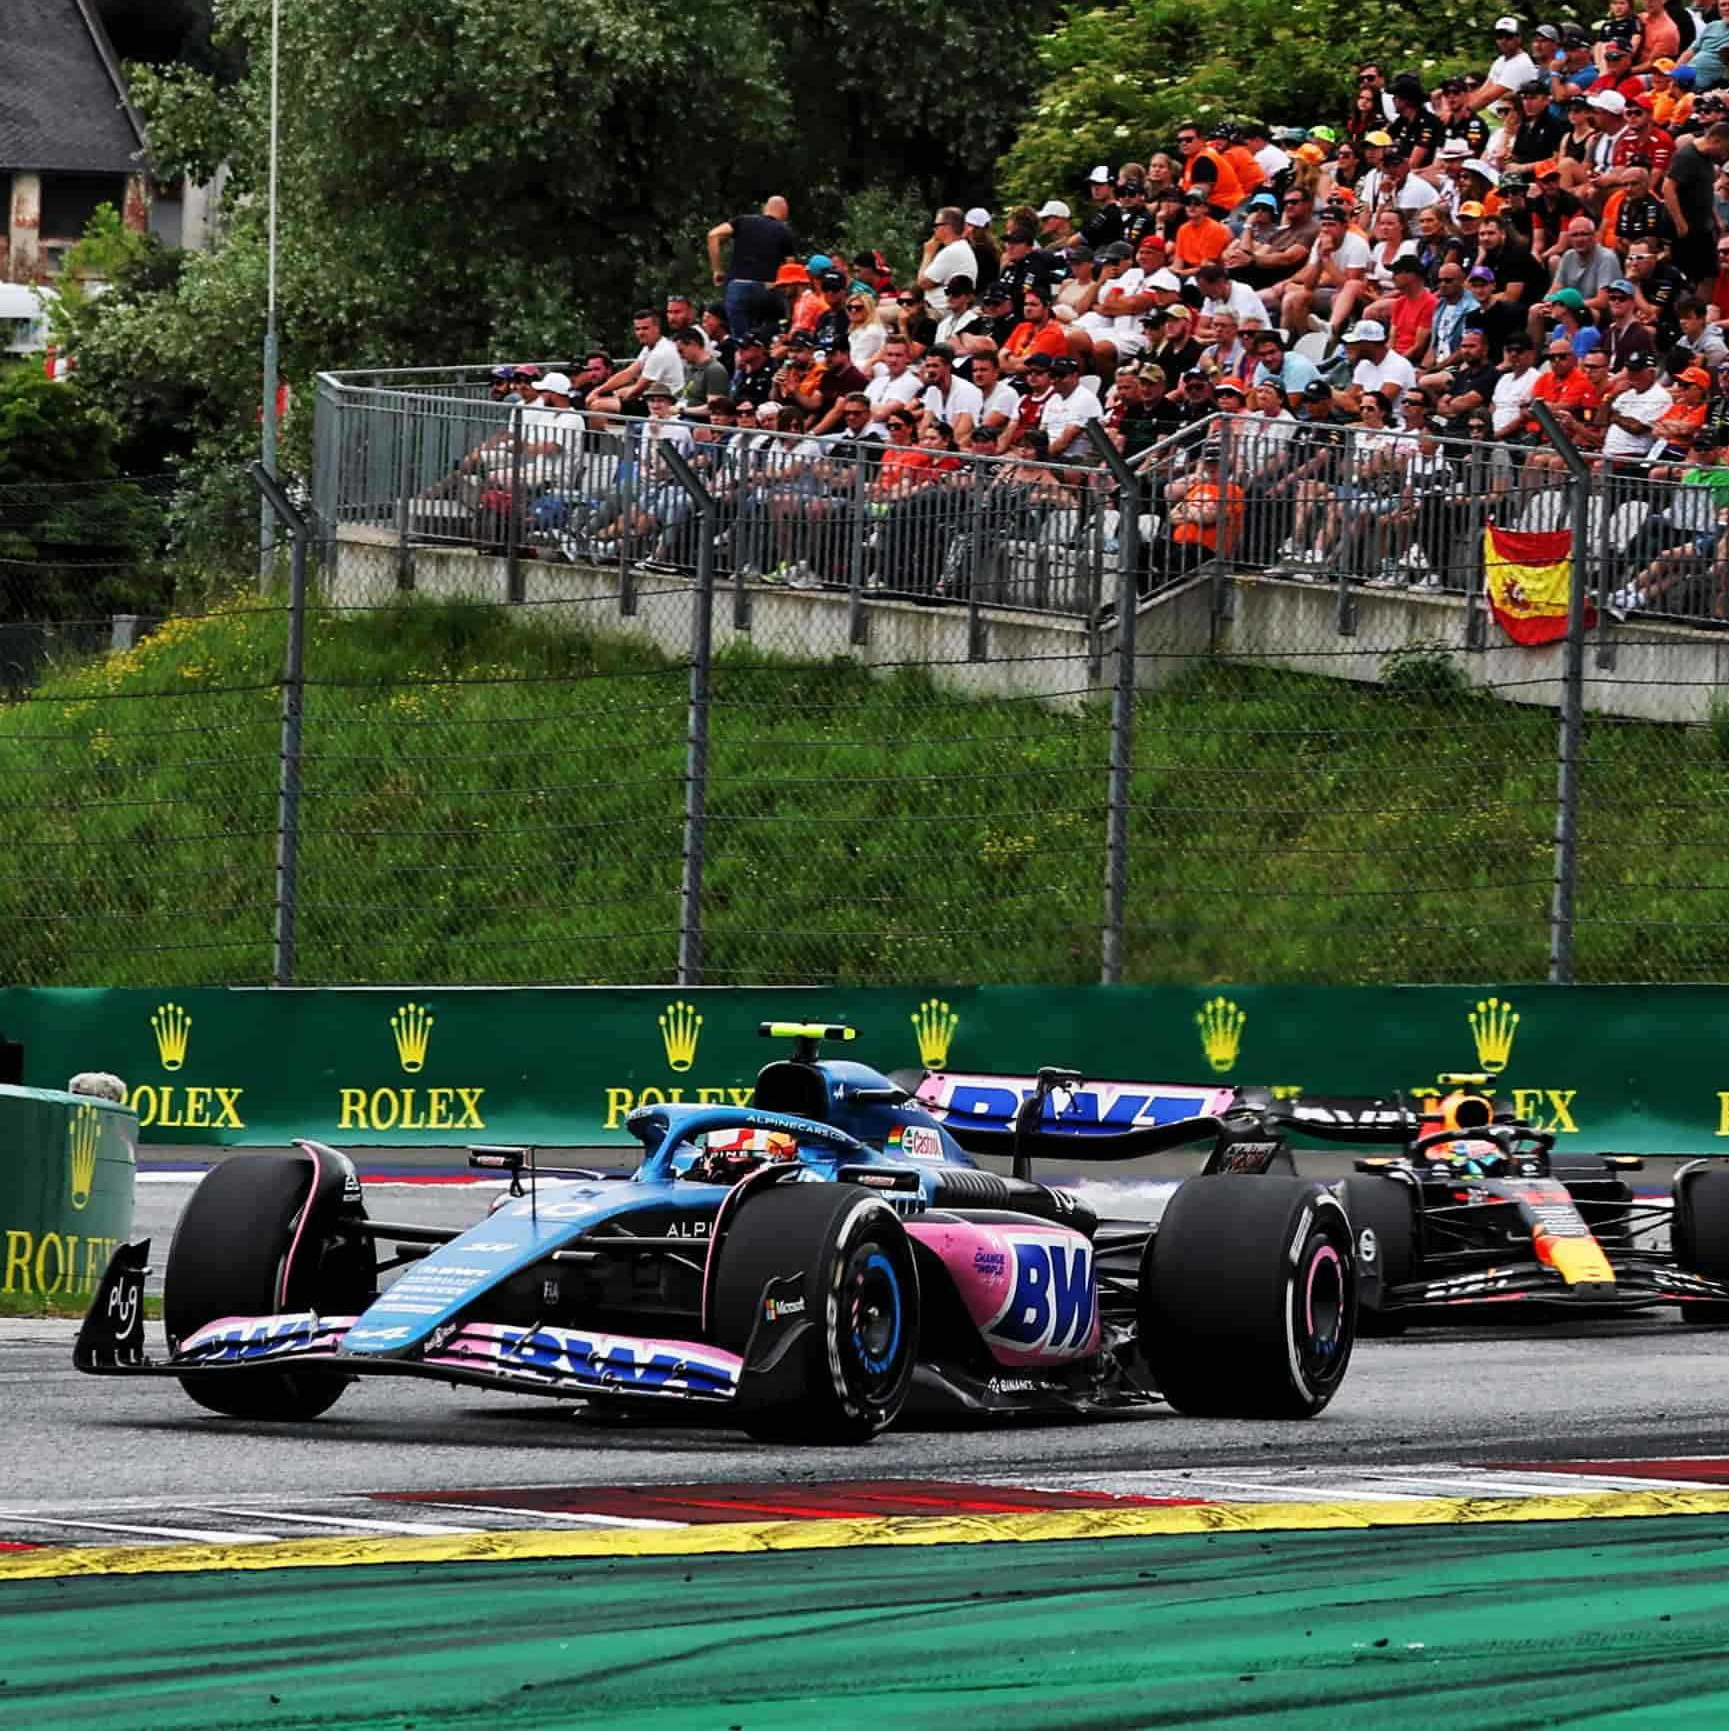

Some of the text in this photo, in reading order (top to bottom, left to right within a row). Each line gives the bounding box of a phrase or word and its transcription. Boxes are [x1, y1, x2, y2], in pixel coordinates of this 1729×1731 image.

[120, 1085, 246, 1129] OLEX
[339, 1087, 485, 1129] ROLEX
[108, 1277, 139, 1340] plug
